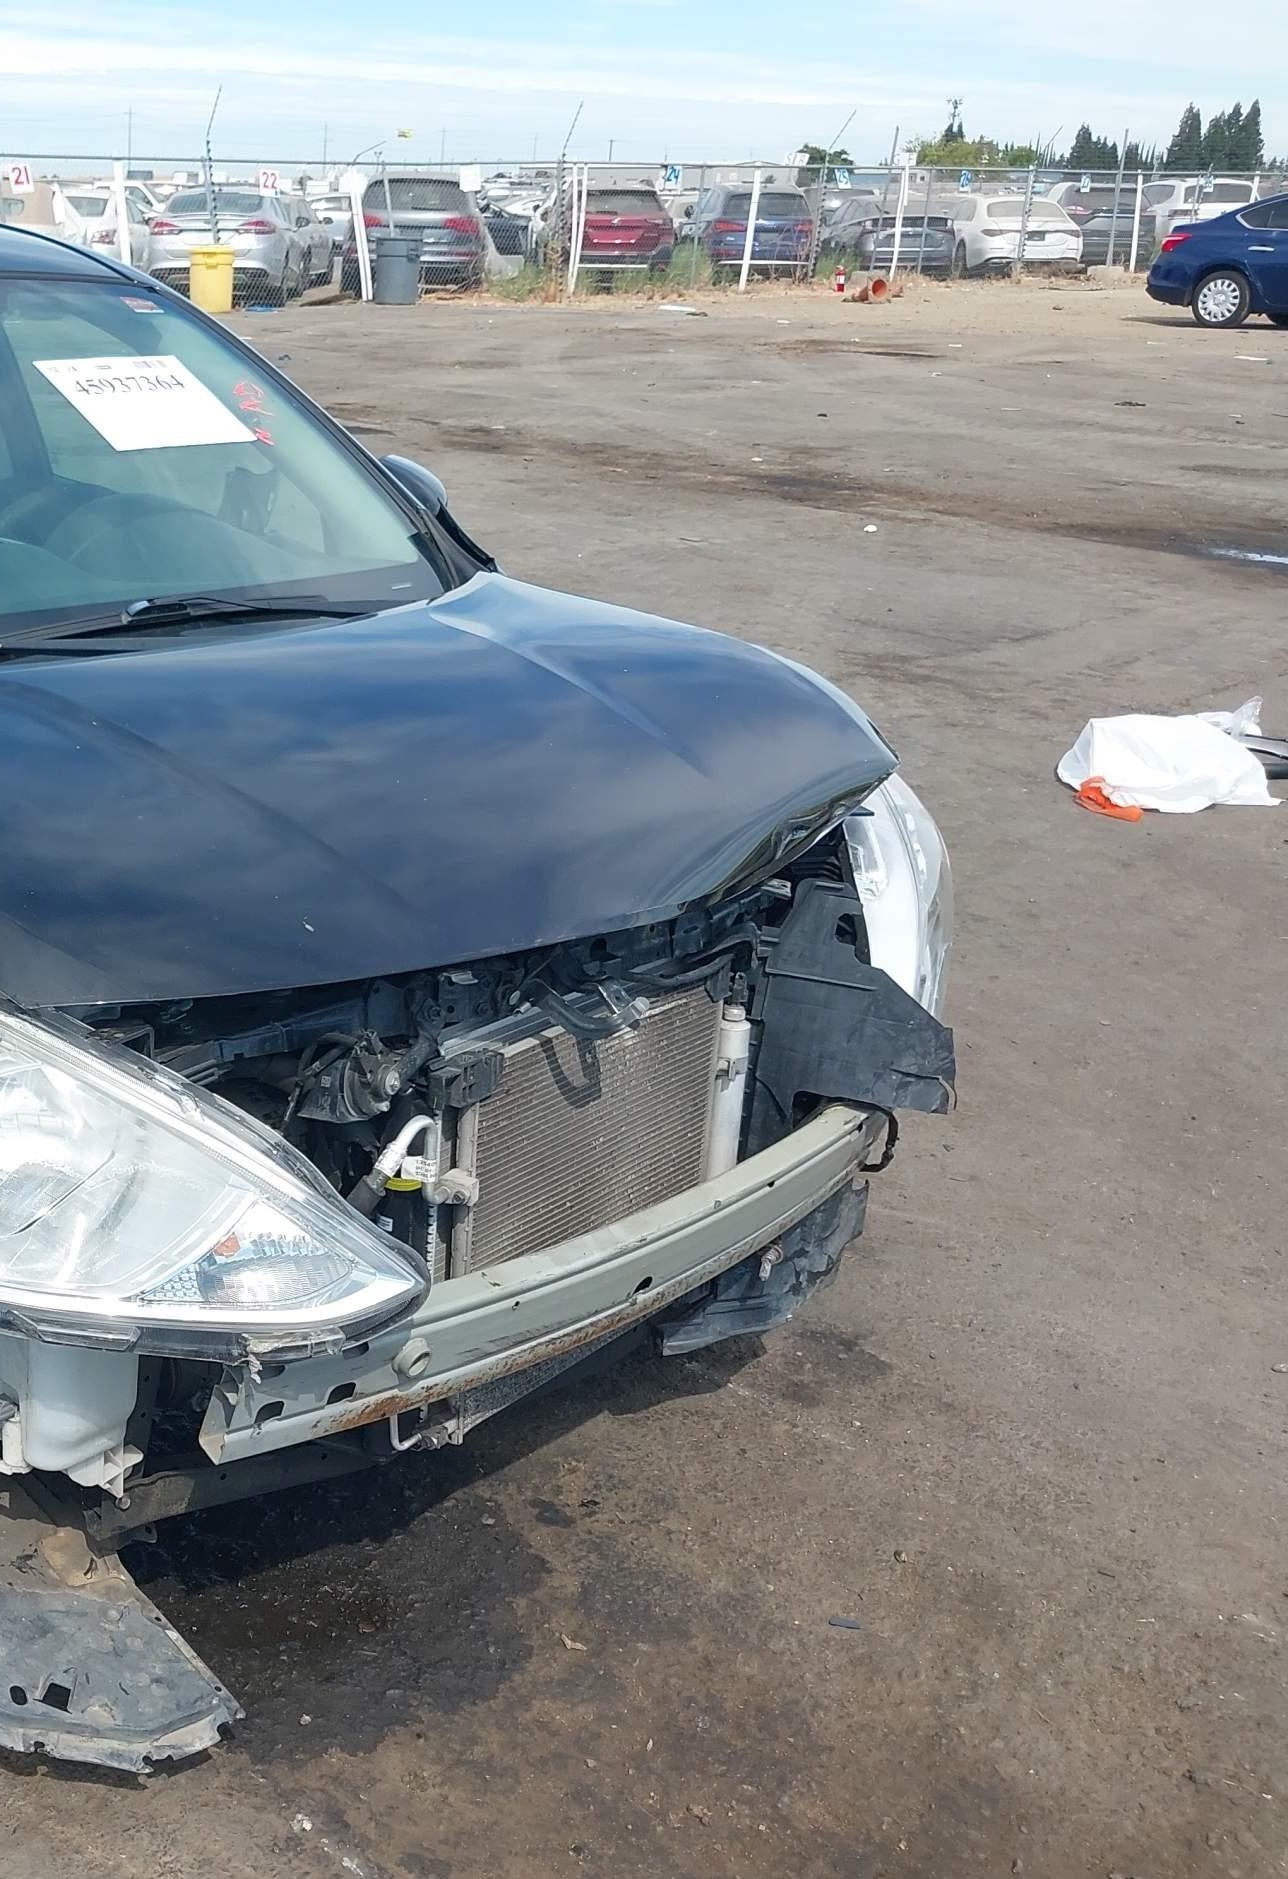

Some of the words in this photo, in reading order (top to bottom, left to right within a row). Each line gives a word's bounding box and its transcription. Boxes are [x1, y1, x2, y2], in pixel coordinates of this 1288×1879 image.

[11, 165, 30, 185] 21
[262, 171, 278, 189] 22
[75, 374, 185, 395] 45937364
